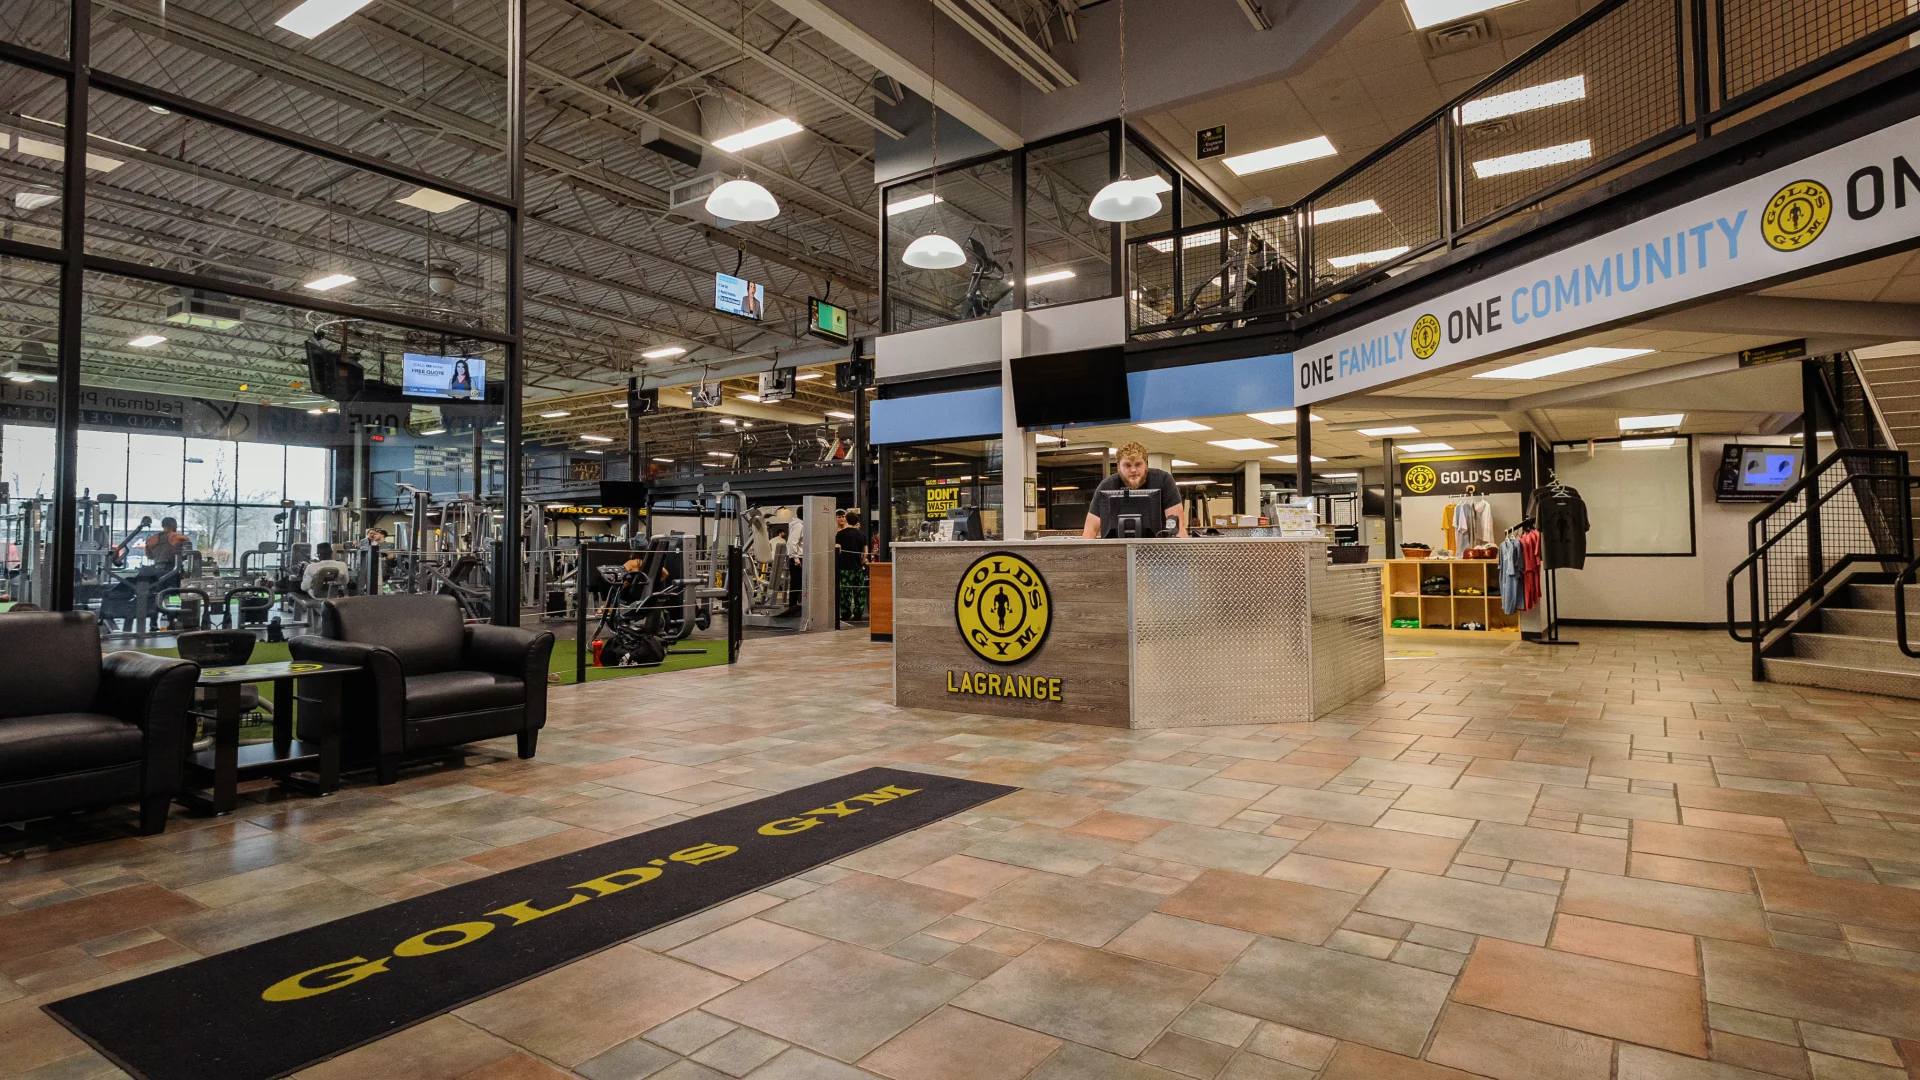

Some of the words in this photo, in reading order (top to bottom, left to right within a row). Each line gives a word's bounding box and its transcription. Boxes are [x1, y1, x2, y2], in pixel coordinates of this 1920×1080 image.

[1766, 185, 1826, 225] GOLD'S
[1773, 219, 1823, 246] GYM
[1447, 295, 1502, 344] ONE
[1511, 208, 1749, 325] COMMUNITY
[1413, 317, 1439, 341] GOLD'S
[1300, 353, 1334, 390] ONE
[1338, 328, 1408, 379] FAMILY
[1415, 341, 1437, 356] GYM
[1408, 467, 1434, 481] GOLD'S
[1440, 470, 1492, 485] GOLD'S
[1494, 468, 1522, 482] GEA
[927, 487, 960, 501] DON'T
[927, 501, 954, 511] WASTE
[963, 561, 1043, 610] GOLD'S
[971, 624, 1038, 655] GYM
[946, 669, 1062, 702] LAGRANGE
[261, 842, 740, 1002] GOLD'S
[757, 784, 923, 837] GYM
